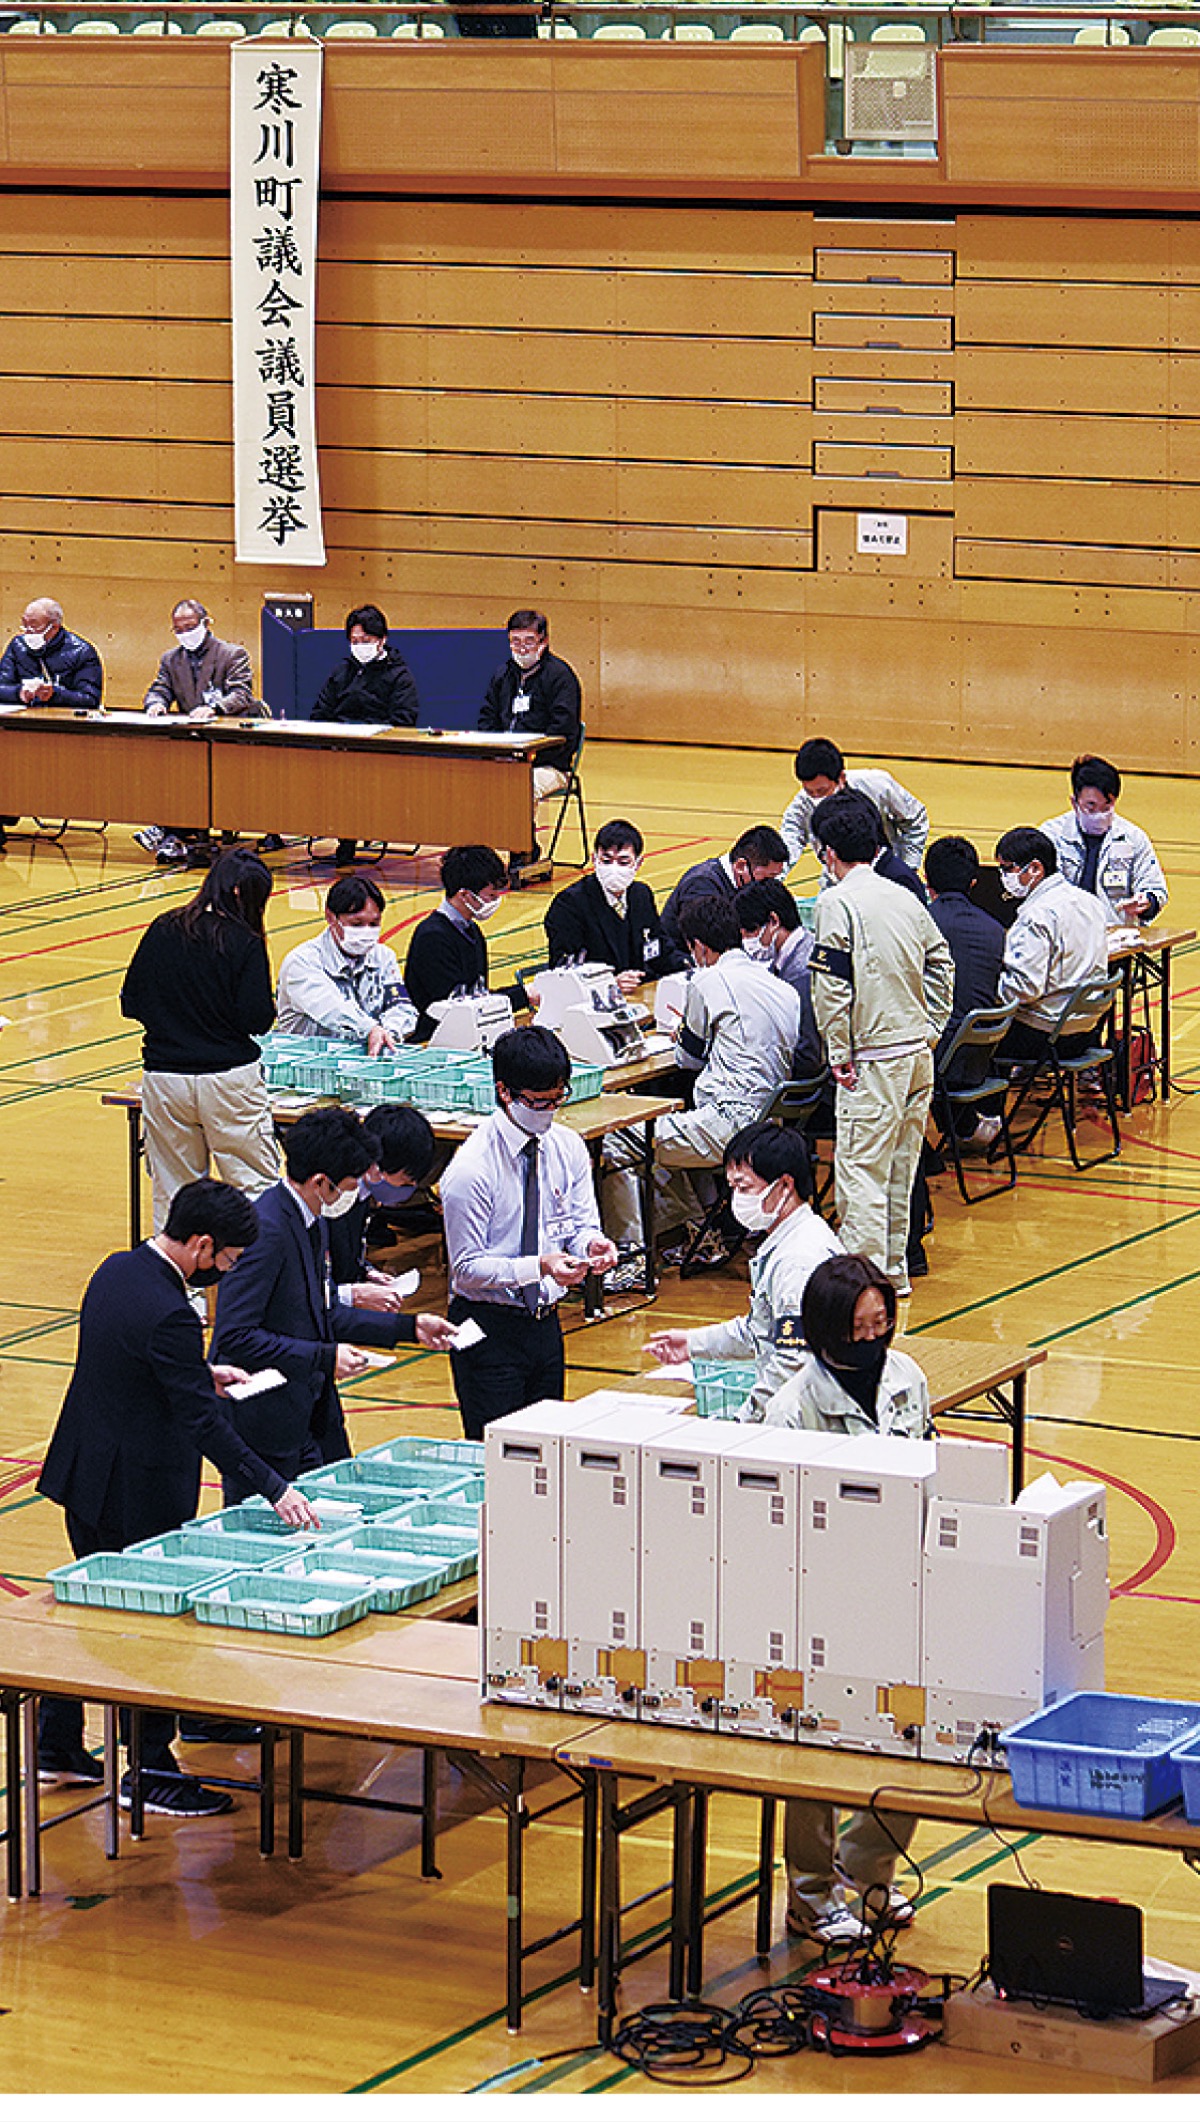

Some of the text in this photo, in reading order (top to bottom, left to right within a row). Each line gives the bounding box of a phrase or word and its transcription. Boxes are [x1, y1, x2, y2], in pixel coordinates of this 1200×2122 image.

[252, 62, 308, 546] 寒川町議会議員選挙
